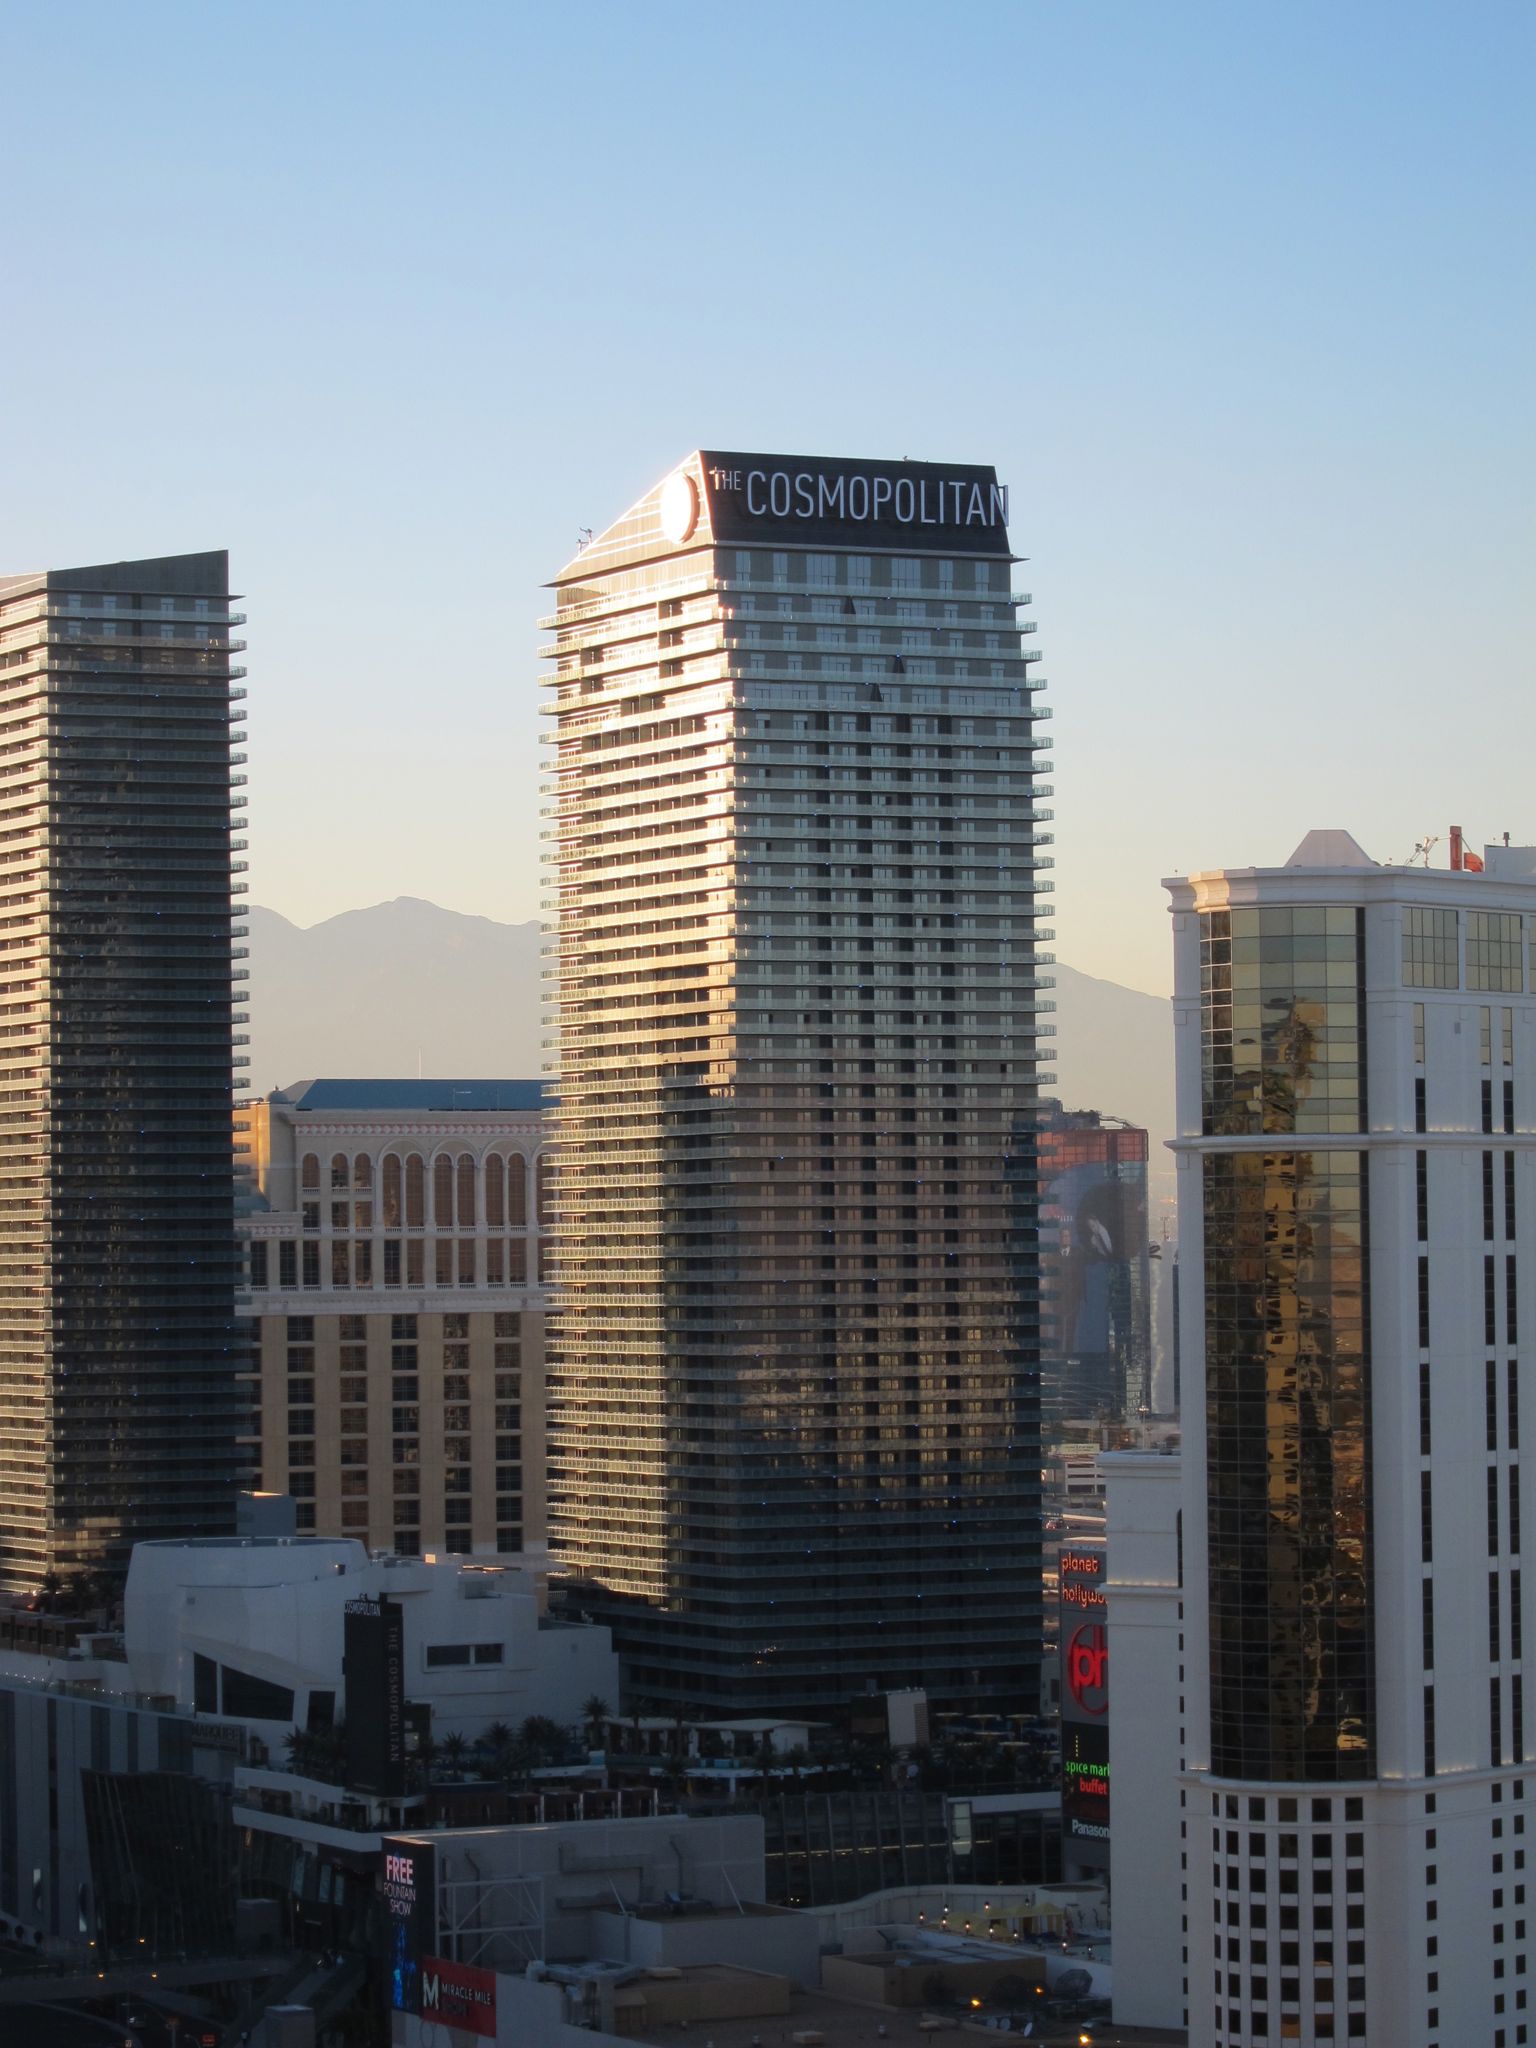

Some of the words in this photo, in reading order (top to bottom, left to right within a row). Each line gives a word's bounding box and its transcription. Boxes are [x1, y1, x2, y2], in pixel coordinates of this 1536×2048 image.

[709, 467, 741, 491] THE
[747, 470, 1009, 528] COSMOPOLITAN
[1061, 1552, 1098, 1576] planet
[1061, 1583, 1109, 1608] hollywo
[388, 1626, 399, 1650] THE
[388, 1657, 400, 1763] COSMOPOLITAN
[1065, 1760, 1088, 1776] spice
[1079, 1776, 1108, 1795] buffet
[1072, 1819, 1110, 1838] Panason
[386, 1854, 414, 1885] FREE
[383, 1882, 416, 1902] FOUNTAIN
[389, 1899, 412, 1916] SHOW
[422, 1970, 439, 2011] M
[441, 1982, 473, 2001] MIRACLE
[474, 1990, 492, 2006] MILE
